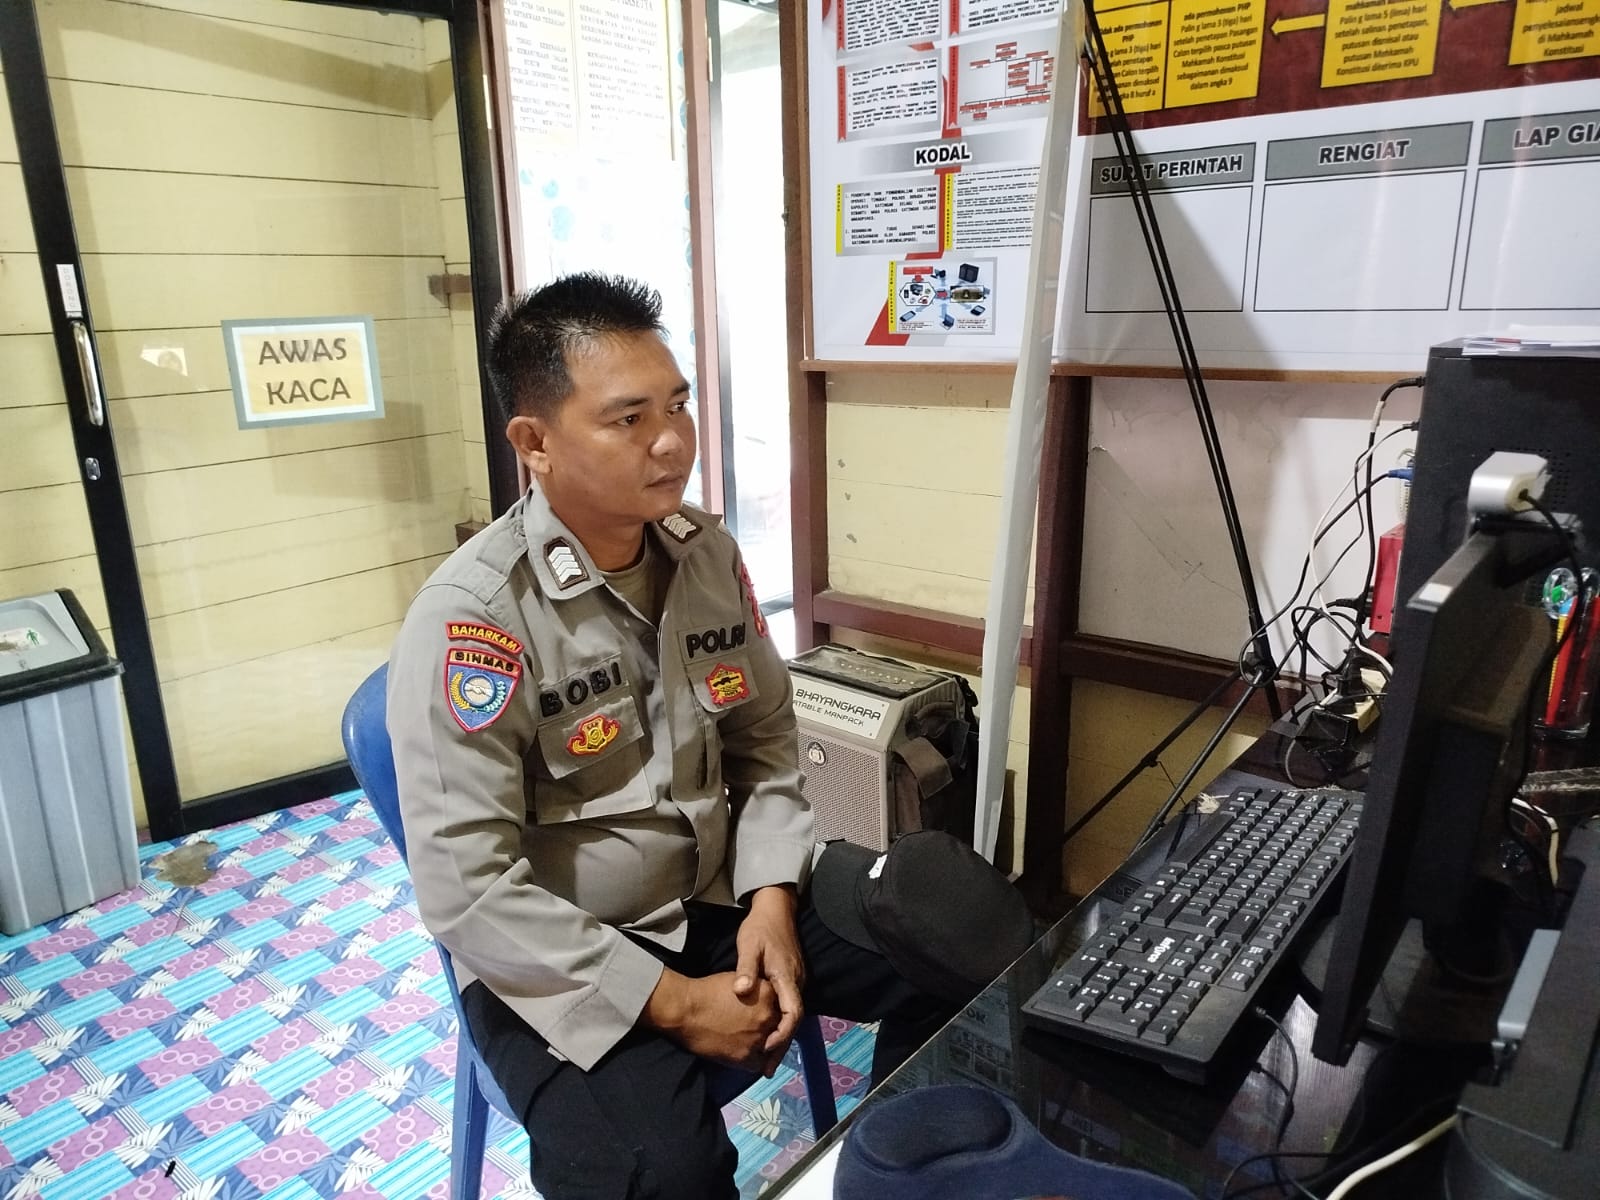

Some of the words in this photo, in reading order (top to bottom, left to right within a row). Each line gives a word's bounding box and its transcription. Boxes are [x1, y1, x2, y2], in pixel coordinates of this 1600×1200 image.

[1318, 139, 1410, 165] RENGIAT
[1513, 127, 1560, 149] LAP
[914, 143, 971, 165] KODAL
[1101, 164, 1154, 183] SUT
[1157, 154, 1243, 179] PERINTAH
[258, 337, 347, 365] AWAS
[266, 377, 351, 405] KACA
[451, 624, 519, 652] BAHARKAM
[686, 622, 747, 659] POLRI
[539, 661, 623, 719] BOBI
[795, 688, 881, 721] BHAYANGKARA
[823, 709, 865, 727] MANPACK
